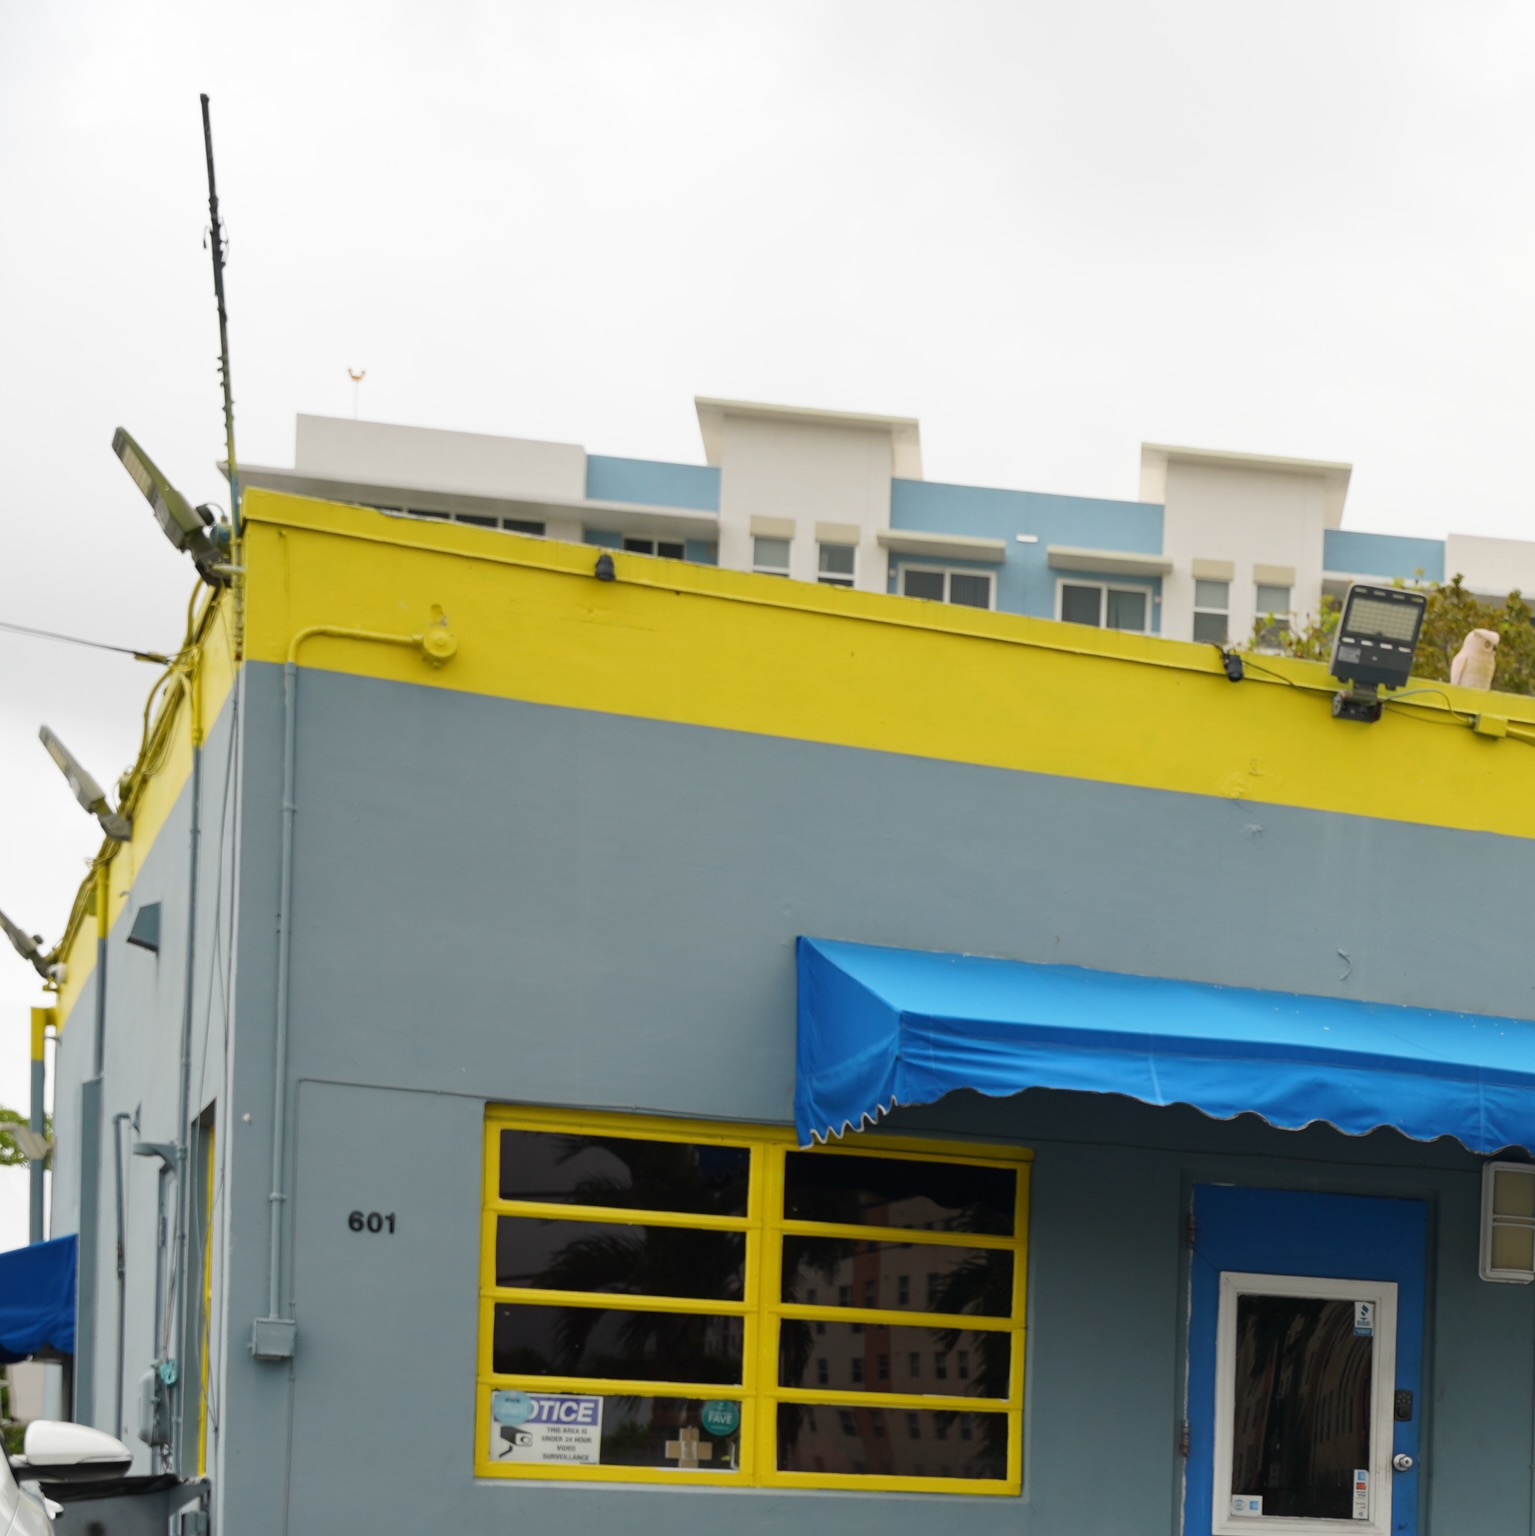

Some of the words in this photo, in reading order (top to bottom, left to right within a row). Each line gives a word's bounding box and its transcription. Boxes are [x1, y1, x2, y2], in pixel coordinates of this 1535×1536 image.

[348, 1210, 396, 1234] 601
[526, 1400, 594, 1423] OTICE
[556, 1444, 577, 1452] VIDEO
